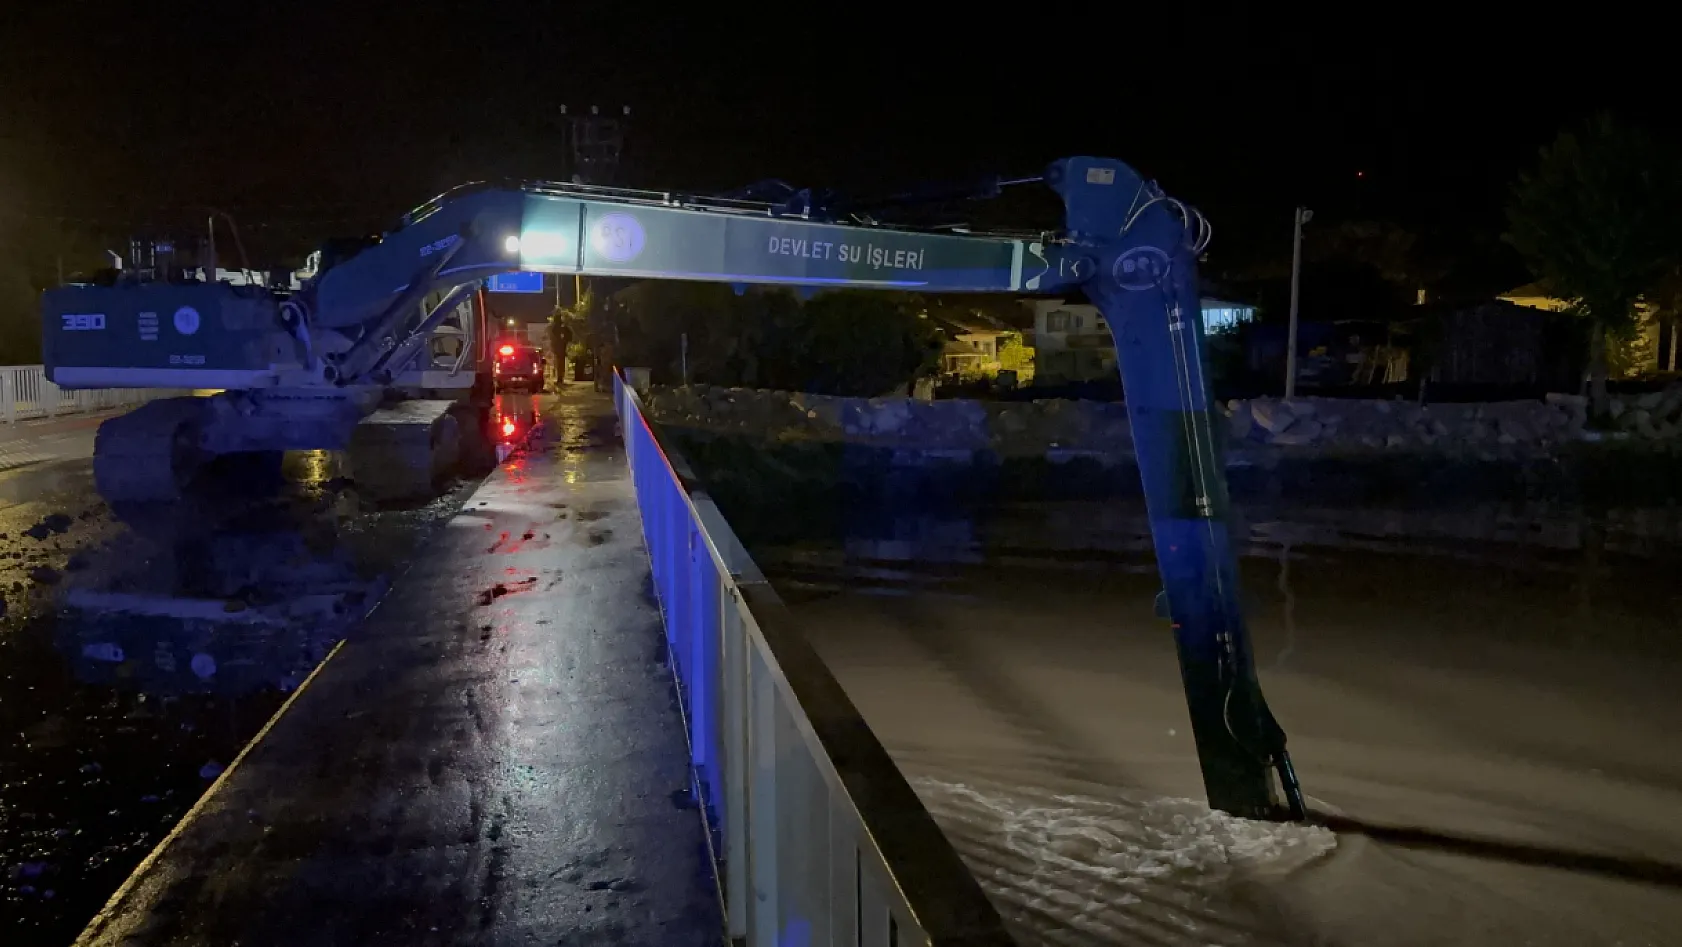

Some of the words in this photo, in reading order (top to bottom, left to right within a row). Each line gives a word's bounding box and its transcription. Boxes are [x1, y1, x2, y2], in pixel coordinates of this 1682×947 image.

[768, 236, 833, 261] DEVLET
[838, 243, 862, 264] SU
[866, 243, 925, 270] İŞLERİ
[61, 313, 106, 331] 390
